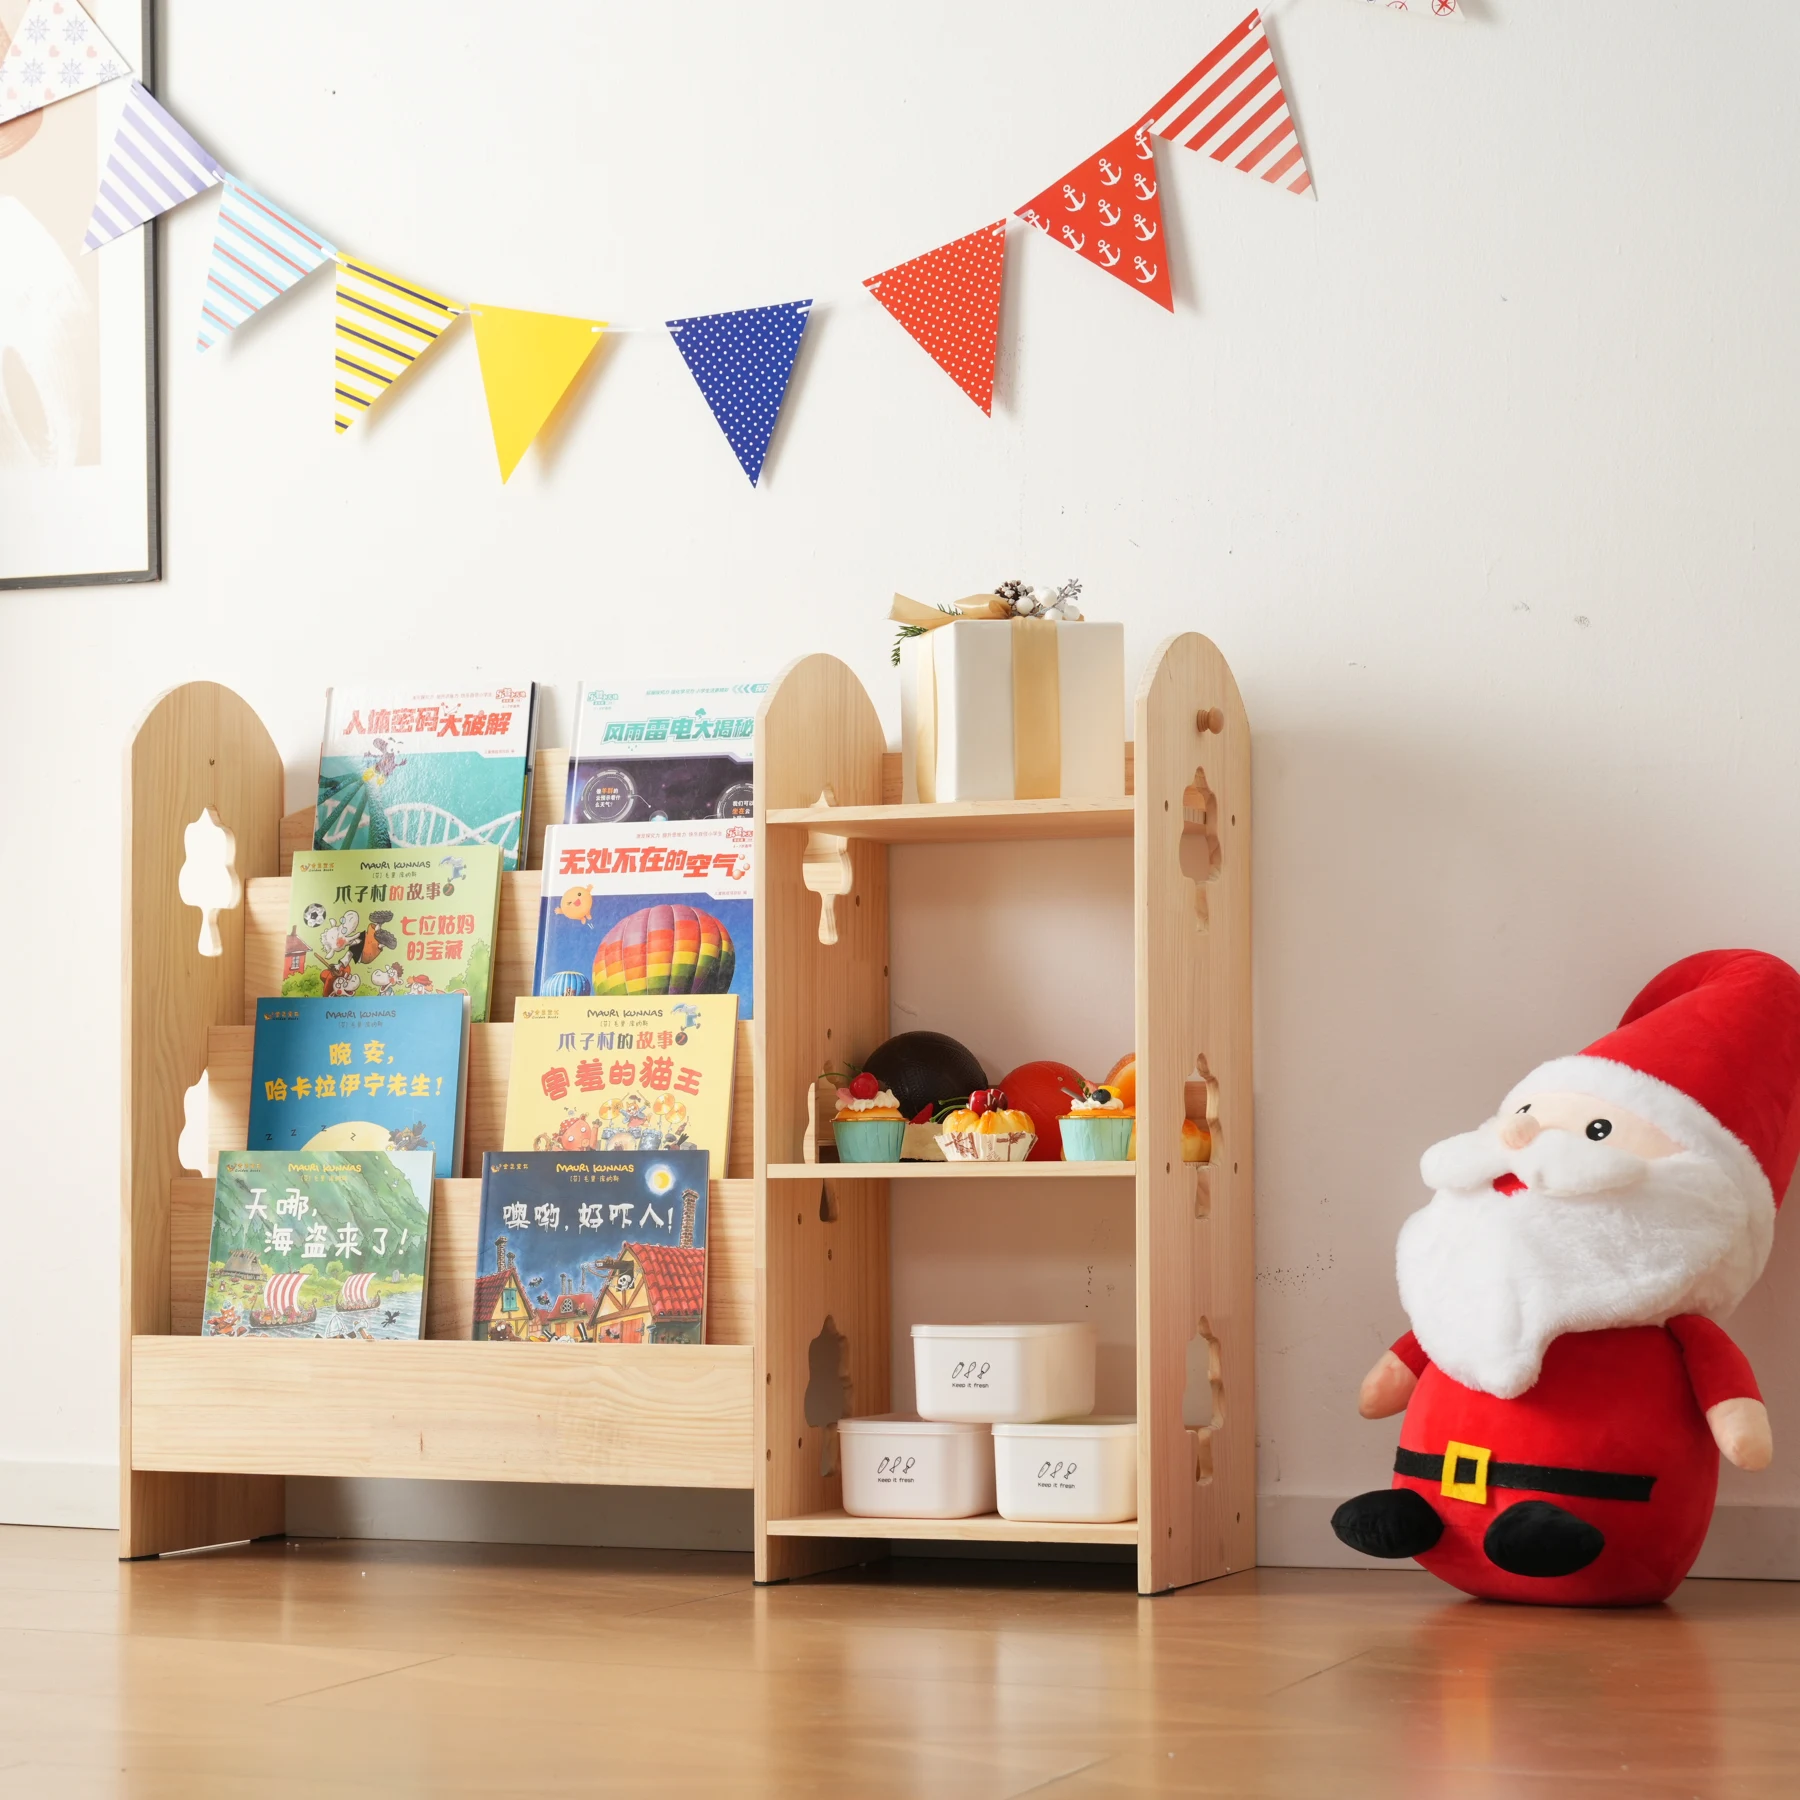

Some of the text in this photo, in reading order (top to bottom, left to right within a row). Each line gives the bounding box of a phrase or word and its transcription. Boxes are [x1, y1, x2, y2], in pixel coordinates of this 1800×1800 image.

[342, 706, 512, 737] 人体密码大破解
[602, 716, 754, 743] 风雨雷电大揭秘
[360, 861, 431, 870] MAURI KUNNAS
[559, 846, 745, 879] 无处不在的空气
[400, 914, 475, 935] 七位姑妈
[407, 939, 464, 961] 的宝藏
[325, 1010, 396, 1019] MAURI KUNNAS
[587, 1009, 663, 1017] MAURI KUNNAS
[264, 1072, 443, 1101] 哈卡拉伊宁先生！
[541, 1055, 703, 1101] 害羞的猫王
[288, 1163, 362, 1172] MAURI KUNNAS
[556, 1163, 635, 1172] MAURI KUNNAS
[263, 1222, 408, 1259] 海盗来了！
